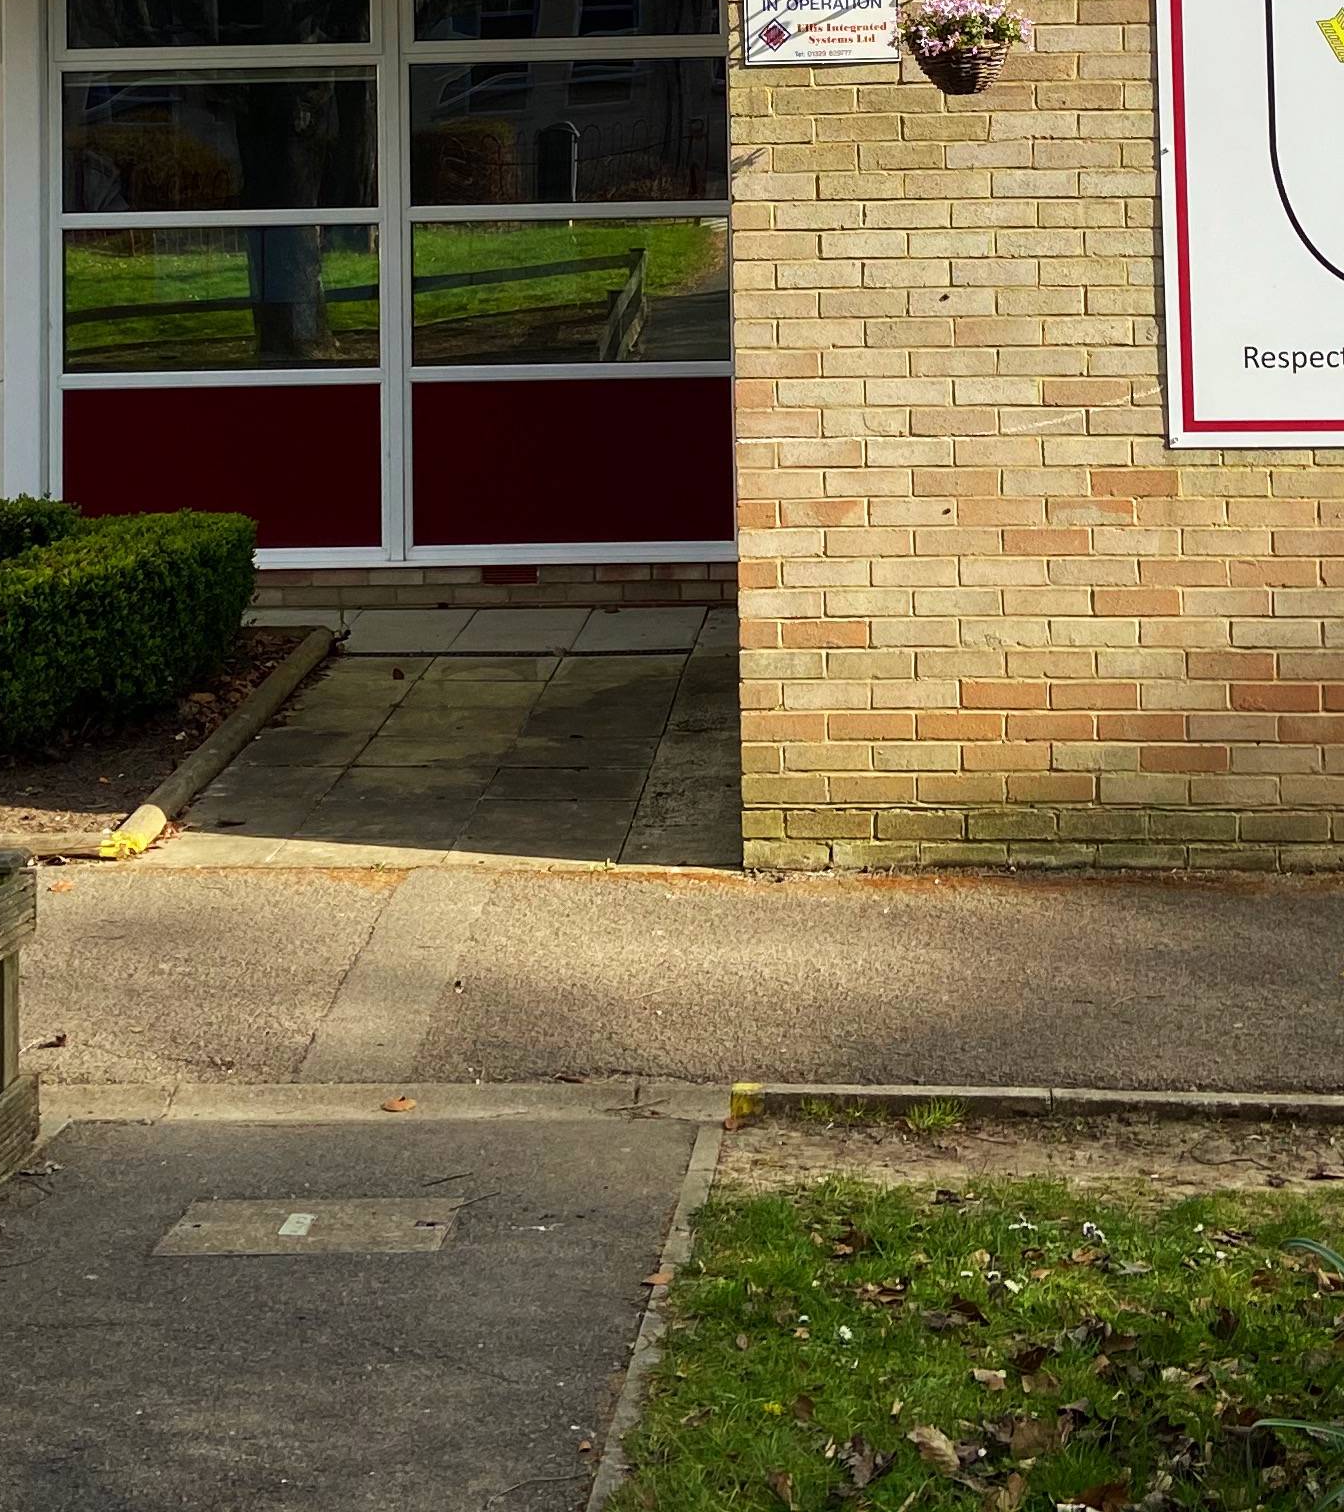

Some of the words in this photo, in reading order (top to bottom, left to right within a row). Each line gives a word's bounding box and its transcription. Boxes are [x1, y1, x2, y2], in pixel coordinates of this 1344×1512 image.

[826, 21, 887, 33] Integrated
[808, 35, 854, 46] Systems
[856, 33, 876, 43] Ltd
